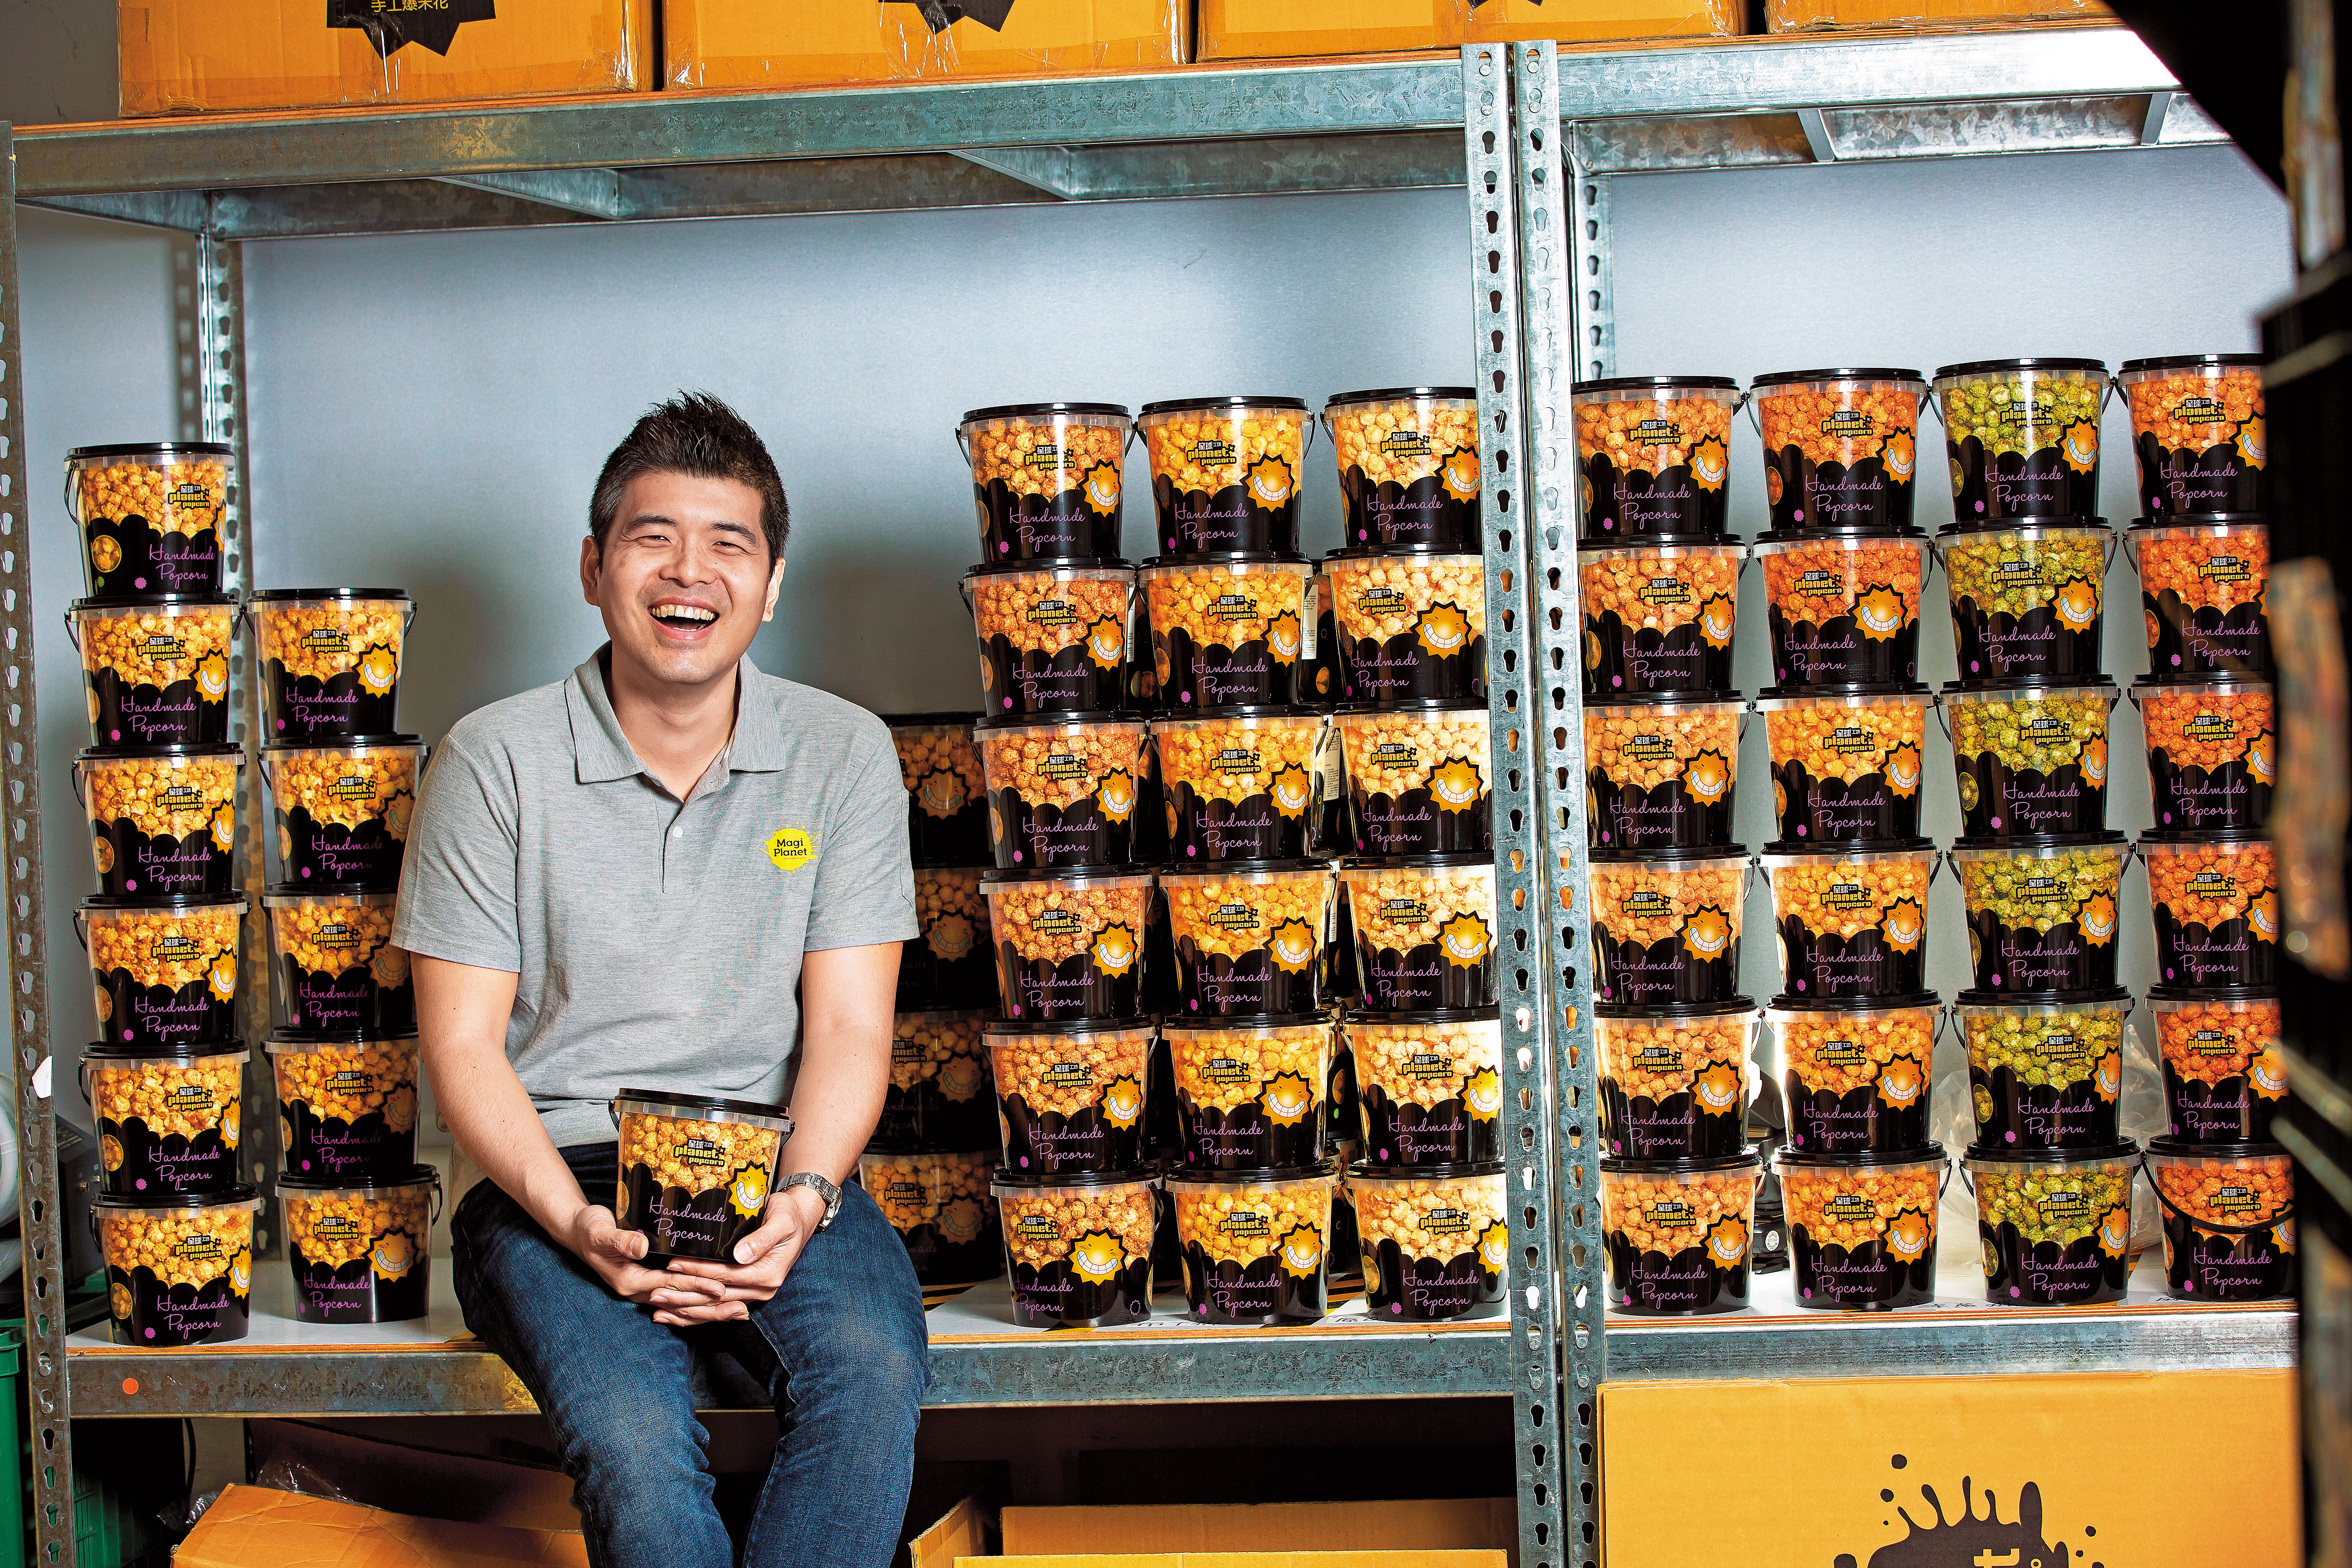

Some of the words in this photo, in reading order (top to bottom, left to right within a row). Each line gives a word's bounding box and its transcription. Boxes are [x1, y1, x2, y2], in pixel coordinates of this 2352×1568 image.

[2175, 405, 2218, 419] planet
[2189, 416, 2224, 424] popcorn
[1631, 428, 1674, 440] planet
[1645, 438, 1679, 446] popcorn
[1382, 439, 1424, 452] planet
[1396, 449, 1430, 457] popcorn
[1188, 448, 1229, 461] planet
[1202, 458, 1235, 466] popcorn
[2161, 461, 2238, 479] Handmade
[1614, 482, 1691, 500] Handmade
[2167, 481, 2227, 508] Popcorn
[1175, 502, 1249, 519] Handmade
[1367, 493, 1443, 511] Handmade
[1621, 502, 1682, 529] Popcorn
[1181, 522, 1238, 548] Popcorn
[1373, 513, 1433, 540] Popcorn
[1993, 569, 2036, 582] planet
[2008, 579, 2042, 588] popcorn
[1795, 578, 1835, 591] planet
[1808, 588, 1842, 597] popcorn
[1029, 608, 1071, 620] planet
[1043, 618, 1076, 626] popcorn
[303, 636, 343, 648] planet
[1784, 633, 1857, 650] Handmade
[1979, 625, 2056, 642] Handmade
[139, 643, 180, 655] planet
[1790, 653, 1846, 680] Popcorn
[1986, 645, 2046, 672] Popcorn
[1013, 662, 1088, 679] Handmade
[286, 686, 359, 703] Handmade
[1019, 682, 1079, 708] Popcorn
[121, 696, 196, 712] Handmade
[292, 706, 348, 731] Popcorn
[128, 715, 187, 741] Popcorn
[2185, 723, 2227, 736] planet
[2199, 734, 2234, 742] popcorn
[1212, 757, 1254, 769] planet
[2171, 777, 2247, 795] Handmade
[158, 794, 198, 806] planet
[1196, 811, 1272, 827] Handmade
[2177, 798, 2237, 825] Popcorn
[774, 848, 807, 856] Planet
[777, 838, 803, 849] Magi
[1203, 830, 1262, 857] Popcorn
[138, 846, 212, 863] Handmade
[145, 865, 203, 891] Popcorn
[1822, 892, 1865, 904] planet
[2018, 885, 2061, 898] planet
[2033, 895, 2067, 904] popcorn
[1381, 907, 1420, 919] planet
[1624, 900, 1664, 912] planet
[1837, 902, 1871, 910] popcorn
[1033, 917, 1074, 930] planet
[1394, 917, 1427, 925] popcorn
[314, 932, 353, 943] planet
[1047, 927, 1080, 935] popcorn
[154, 944, 195, 956] planet
[1806, 945, 1884, 962] Handmade
[2002, 940, 2080, 957] Handmade
[167, 954, 199, 962] popcorn
[1611, 953, 1685, 970] Handmade
[1371, 960, 1441, 977] Handmade
[2009, 960, 2070, 987] Popcorn
[1020, 970, 1094, 987] Handmade
[1617, 973, 1674, 1000] Popcorn
[1813, 965, 1873, 993] Popcorn
[1376, 980, 1431, 1007] Popcorn
[135, 996, 209, 1013] Handmade
[1027, 990, 1084, 1016] Popcorn
[306, 1001, 359, 1027] Popcorn
[142, 1016, 200, 1042] Popcorn
[2188, 1038, 2228, 1050] planet
[1817, 1049, 1859, 1060] planet
[1831, 1059, 1865, 1067] popcorn
[1044, 1070, 1086, 1082] planet
[1404, 1062, 1446, 1074] planet
[1418, 1072, 1452, 1080] popcorn
[1058, 1080, 1092, 1089] popcorn
[2178, 1091, 2250, 1109] Handmade
[1804, 1101, 1878, 1118] Handmade
[1029, 1123, 1104, 1140] Handmade
[1388, 1115, 1465, 1132] Handmade
[2183, 1111, 2240, 1139] Popcorn
[1810, 1121, 1868, 1149] Popcorn
[675, 1145, 719, 1158] planet
[1036, 1143, 1094, 1169] Popcorn
[1395, 1135, 1454, 1162] Popcorn
[689, 1157, 724, 1165] popcorn
[885, 1189, 920, 1199] planet
[649, 1196, 726, 1222] Handmade
[1647, 1210, 1689, 1222] planet
[314, 1224, 352, 1235] planet
[654, 1218, 714, 1247] Popcorn
[1221, 1220, 1262, 1231] planet
[1661, 1220, 1695, 1228] popcorn
[177, 1242, 217, 1255] planet
[191, 1252, 221, 1261] popcorn
[1631, 1262, 1708, 1279] Handmade
[304, 1272, 372, 1290] Handmade
[1207, 1271, 1281, 1288] Handmade
[157, 1294, 230, 1311] Handmade
[1638, 1282, 1697, 1309] Popcorn
[310, 1292, 361, 1317] Popcorn
[1213, 1291, 1271, 1318] Popcorn
[164, 1314, 221, 1339] Popcorn
